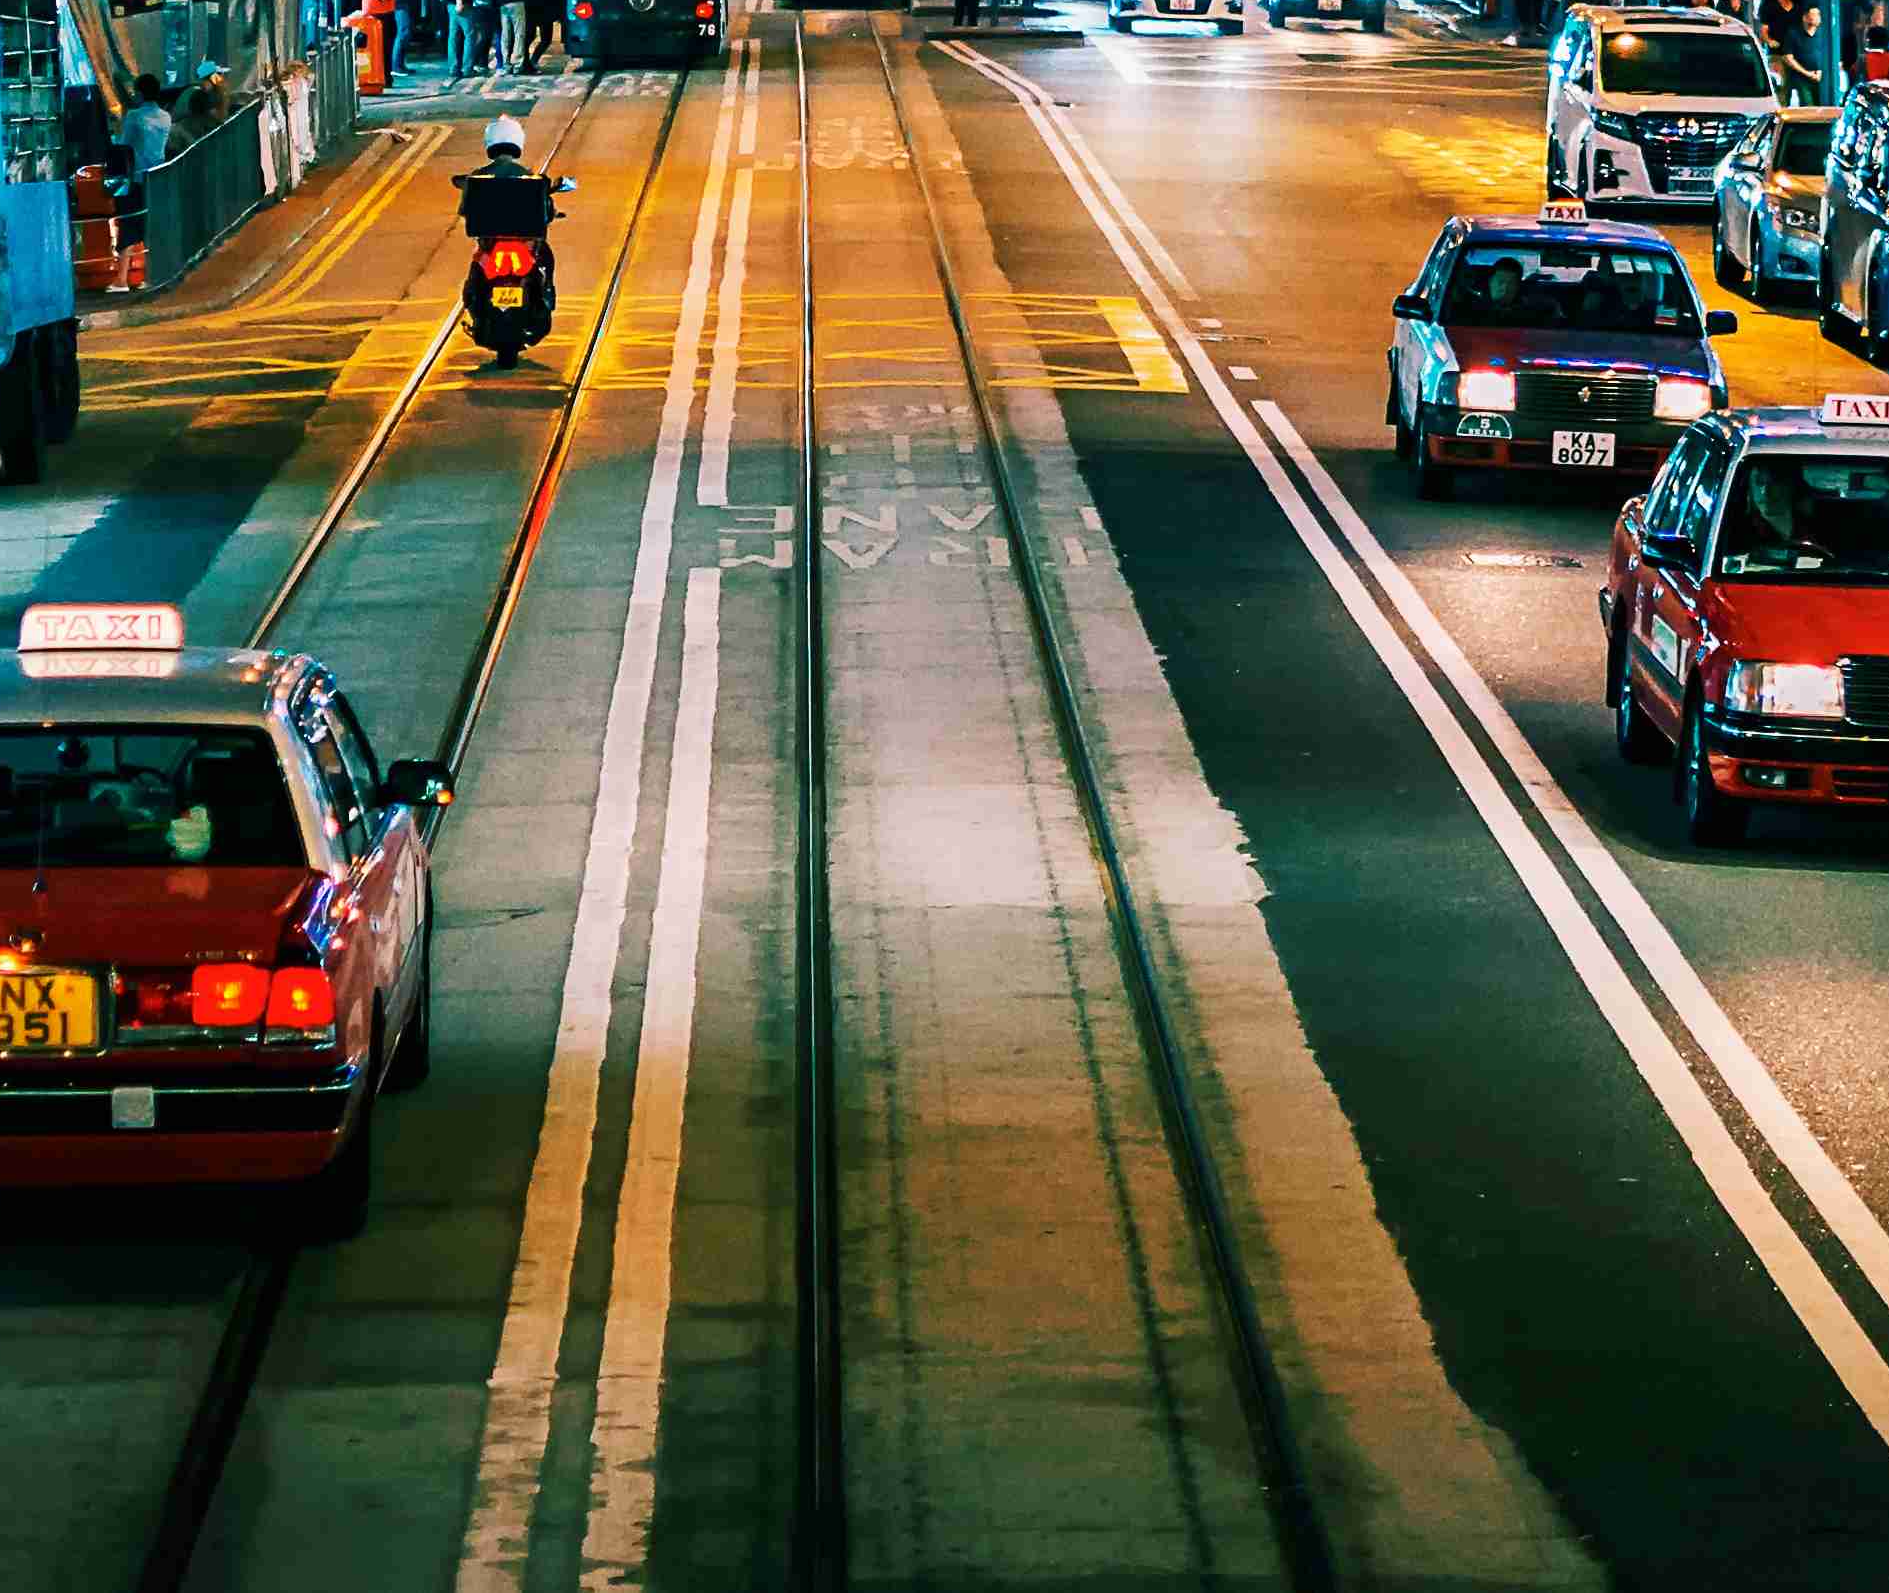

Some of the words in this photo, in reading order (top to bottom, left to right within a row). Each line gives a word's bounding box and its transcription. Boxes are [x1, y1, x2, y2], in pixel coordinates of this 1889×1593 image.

[1545, 205, 1584, 221] TAXI
[1831, 399, 1889, 419] TAXI
[1570, 433, 1597, 449] KA
[1557, 448, 1610, 465] 8077
[35, 614, 164, 643] TAXI
[0, 981, 56, 1011] NX
